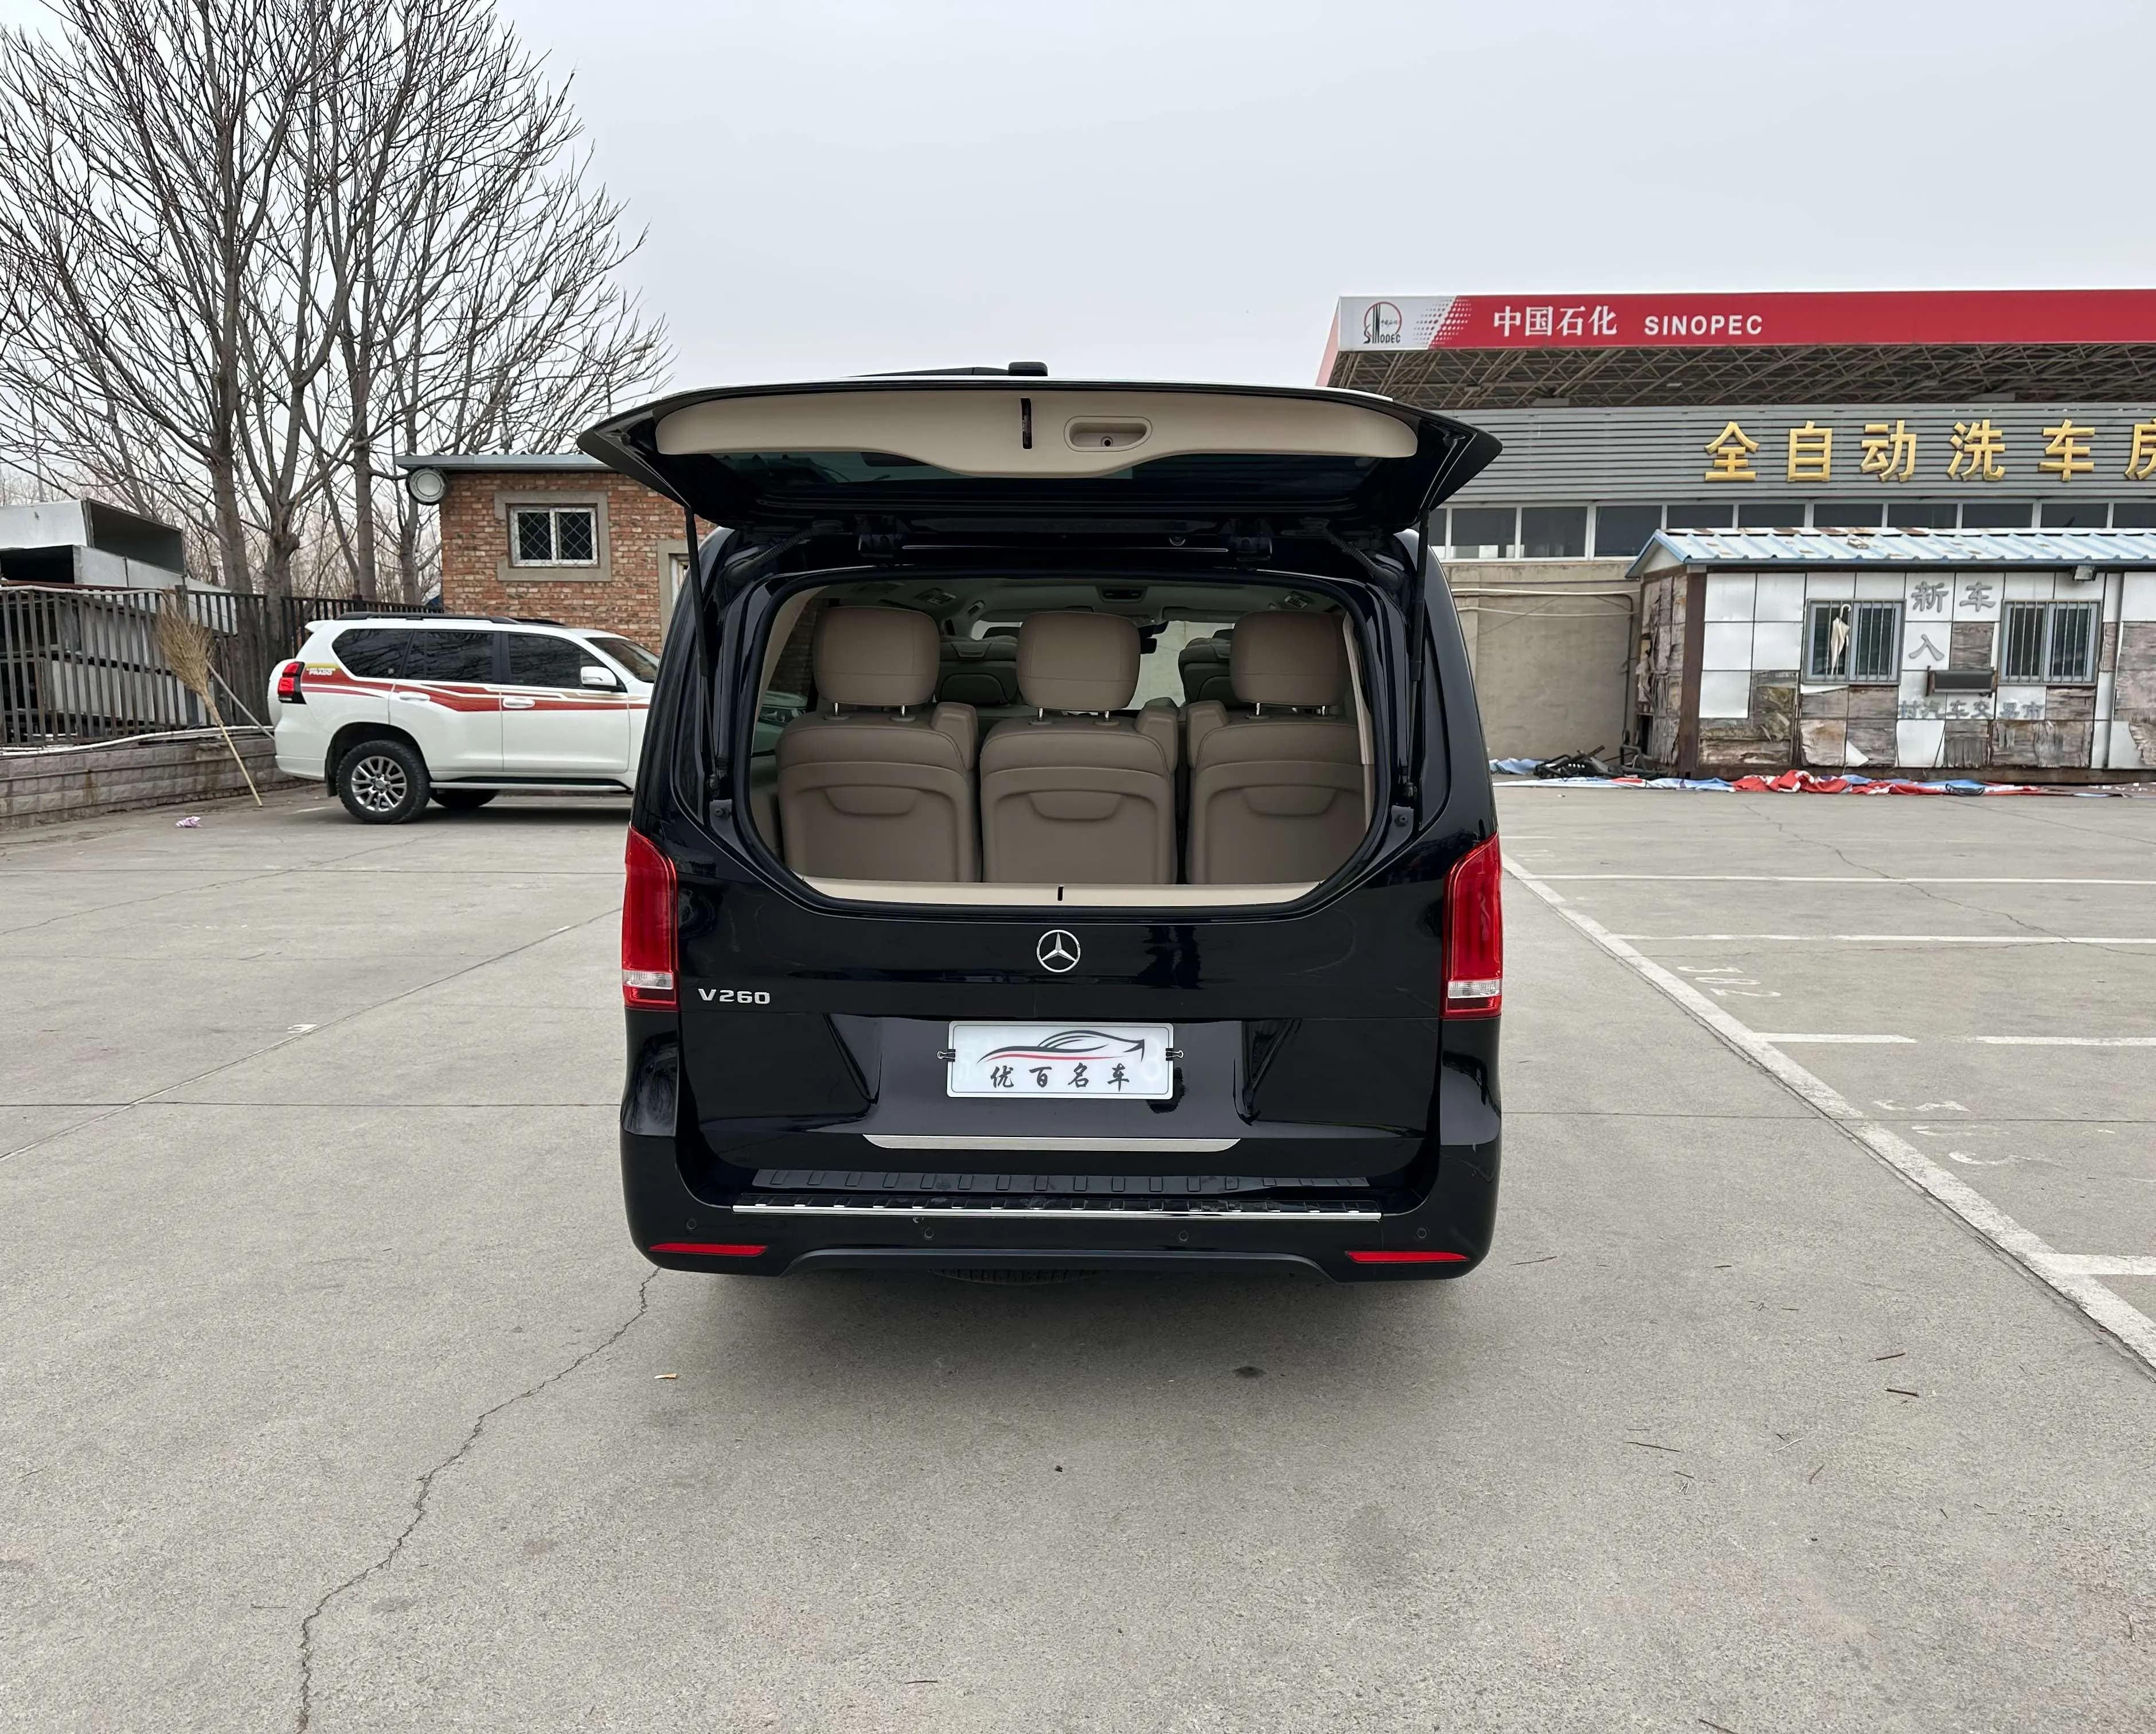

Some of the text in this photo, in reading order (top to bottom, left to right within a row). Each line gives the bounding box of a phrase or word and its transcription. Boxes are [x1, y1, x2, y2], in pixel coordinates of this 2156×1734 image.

[1494, 305, 1617, 337] 中国石化
[1645, 315, 1762, 335] SINOPEC
[1911, 581, 1997, 613] 新车
[1908, 634, 1945, 661] 入
[698, 988, 770, 1004] V260
[990, 1062, 1130, 1092] 优百名车
